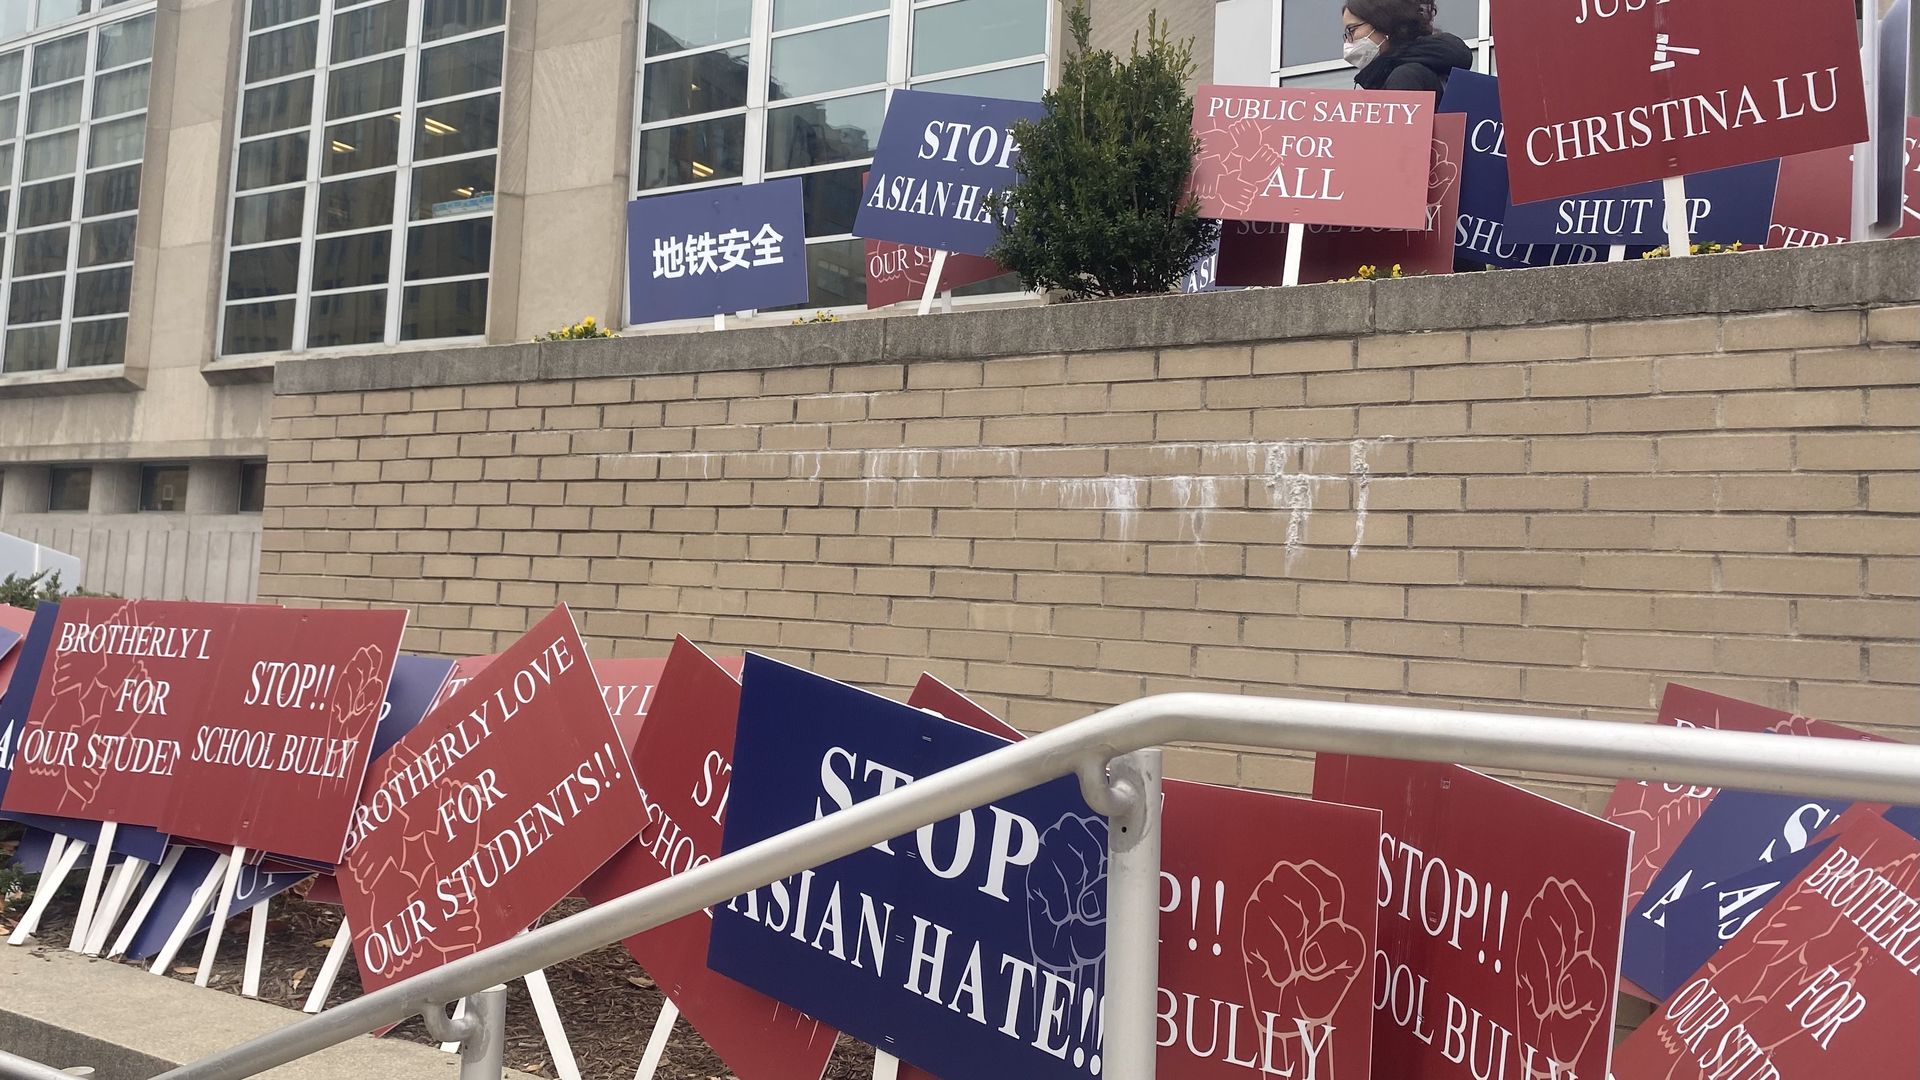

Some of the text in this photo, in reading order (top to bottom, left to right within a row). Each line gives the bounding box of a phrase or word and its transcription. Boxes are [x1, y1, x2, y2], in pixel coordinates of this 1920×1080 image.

[1207, 97, 1422, 125] PUBLIC SAFETY
[1525, 66, 1839, 166] CHRISTINA LU
[1280, 136, 1335, 159] FOR
[867, 174, 953, 217] ASIAN
[1261, 167, 1345, 201] ALL
[1555, 199, 1712, 235] SHUT P
[652, 223, 784, 280] 地铁安全
[870, 248, 909, 278] OUR
[57, 622, 198, 659] BROTHERLY
[116, 677, 171, 716] FOR
[244, 660, 336, 711] STOP!!
[494, 636, 574, 723] LOVE
[23, 728, 79, 768] OUR
[191, 725, 359, 778] SCHOOL BULLY
[437, 767, 508, 843] FOR
[364, 742, 622, 975] OUR STUDENTS!!
[1377, 832, 1509, 974] STOP!!
[904, 914, 1105, 1076] HATE!!
[1667, 978, 1730, 1054] OUR
[1785, 964, 1867, 1051] FOR
[1156, 987, 1337, 1080] BULLY
